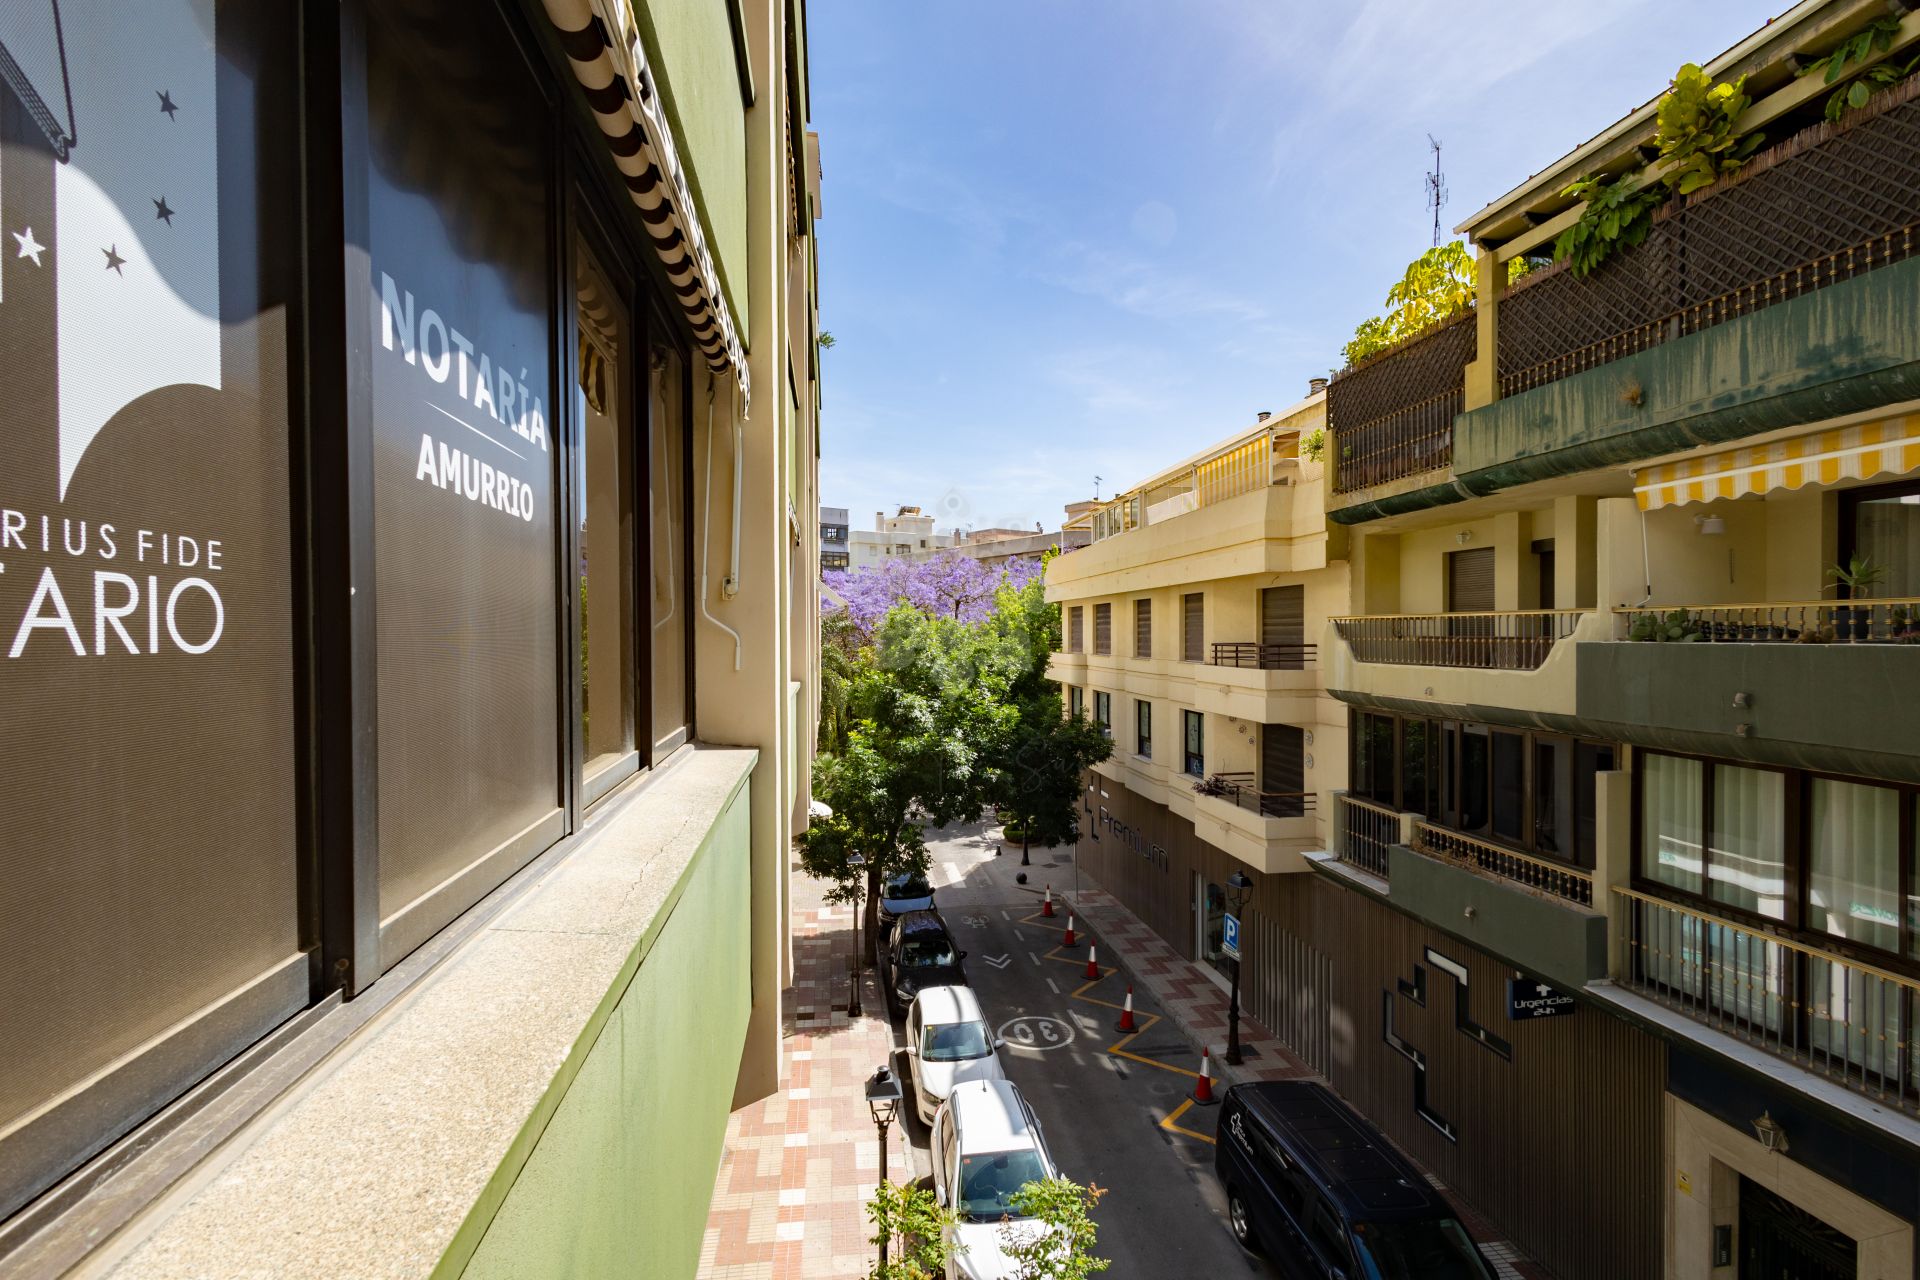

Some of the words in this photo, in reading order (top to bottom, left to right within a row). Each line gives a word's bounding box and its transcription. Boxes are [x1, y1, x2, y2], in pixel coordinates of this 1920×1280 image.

[381, 271, 547, 452] NOTARÍA
[416, 433, 534, 522] AMURRIO
[138, 529, 222, 570] FIDE
[0, 562, 225, 658] ARIO
[1099, 805, 1169, 874] Premium
[1226, 918, 1236, 942] P
[1514, 995, 1574, 1009] Urgencias
[1013, 1021, 1059, 1044] 30
